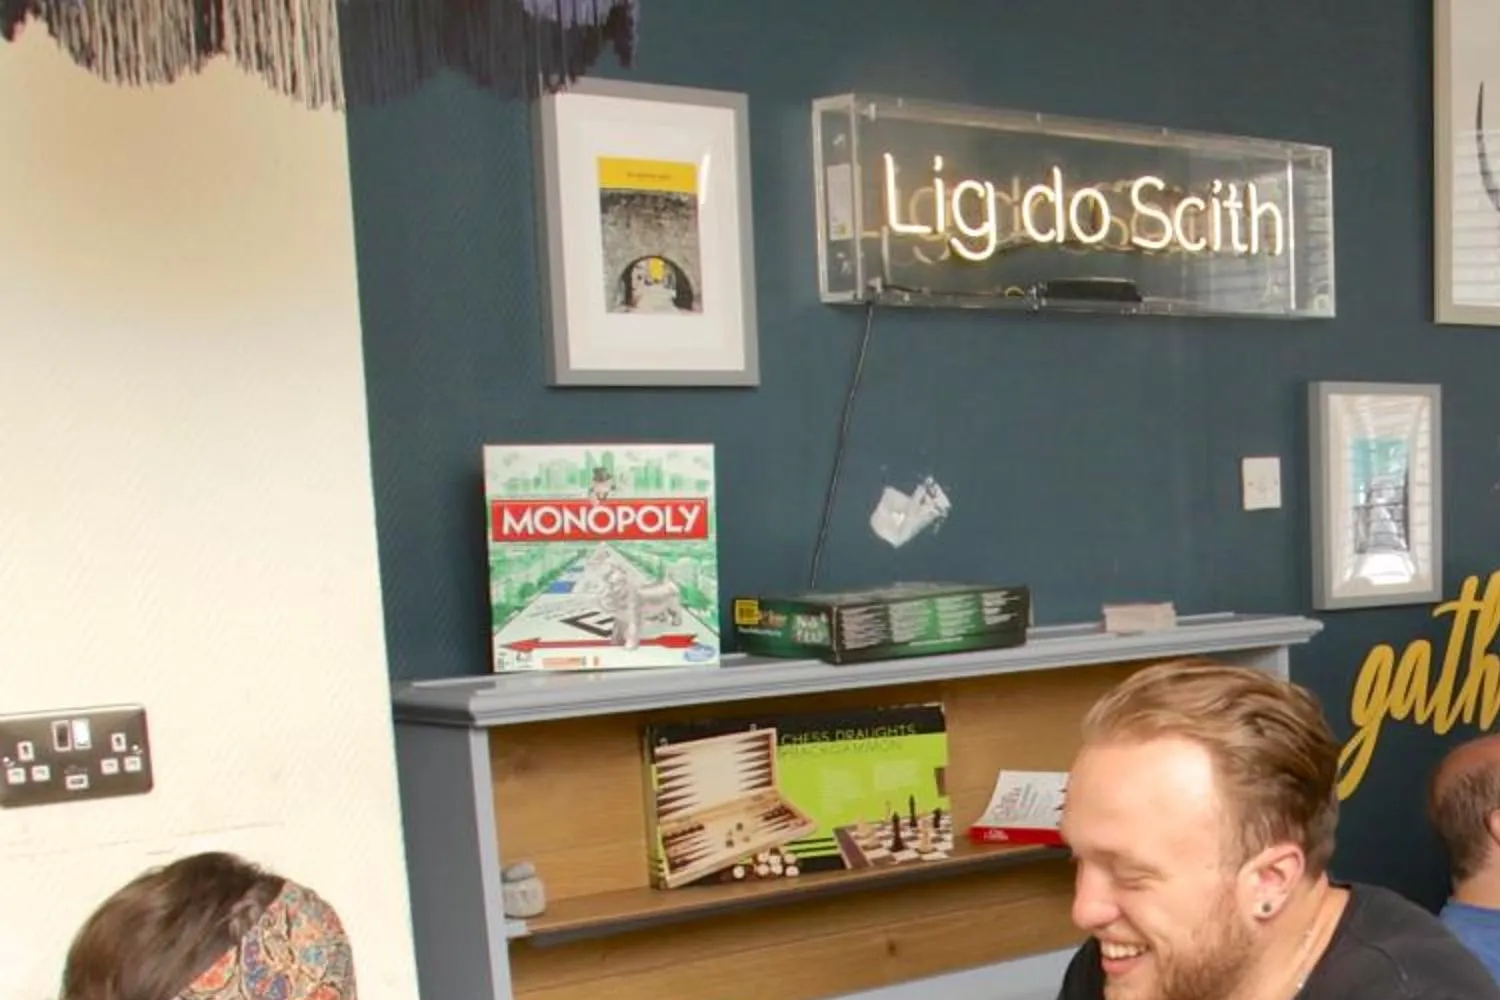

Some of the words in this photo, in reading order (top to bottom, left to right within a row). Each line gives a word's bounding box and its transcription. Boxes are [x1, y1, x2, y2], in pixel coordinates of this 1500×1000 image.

[883, 152, 998, 262] Lig
[1022, 165, 1111, 244] do
[1131, 175, 1284, 257] Scith
[501, 504, 702, 535] MONOPOLY
[781, 731, 831, 745] CHESS
[835, 723, 917, 741] DRAUGHTS
